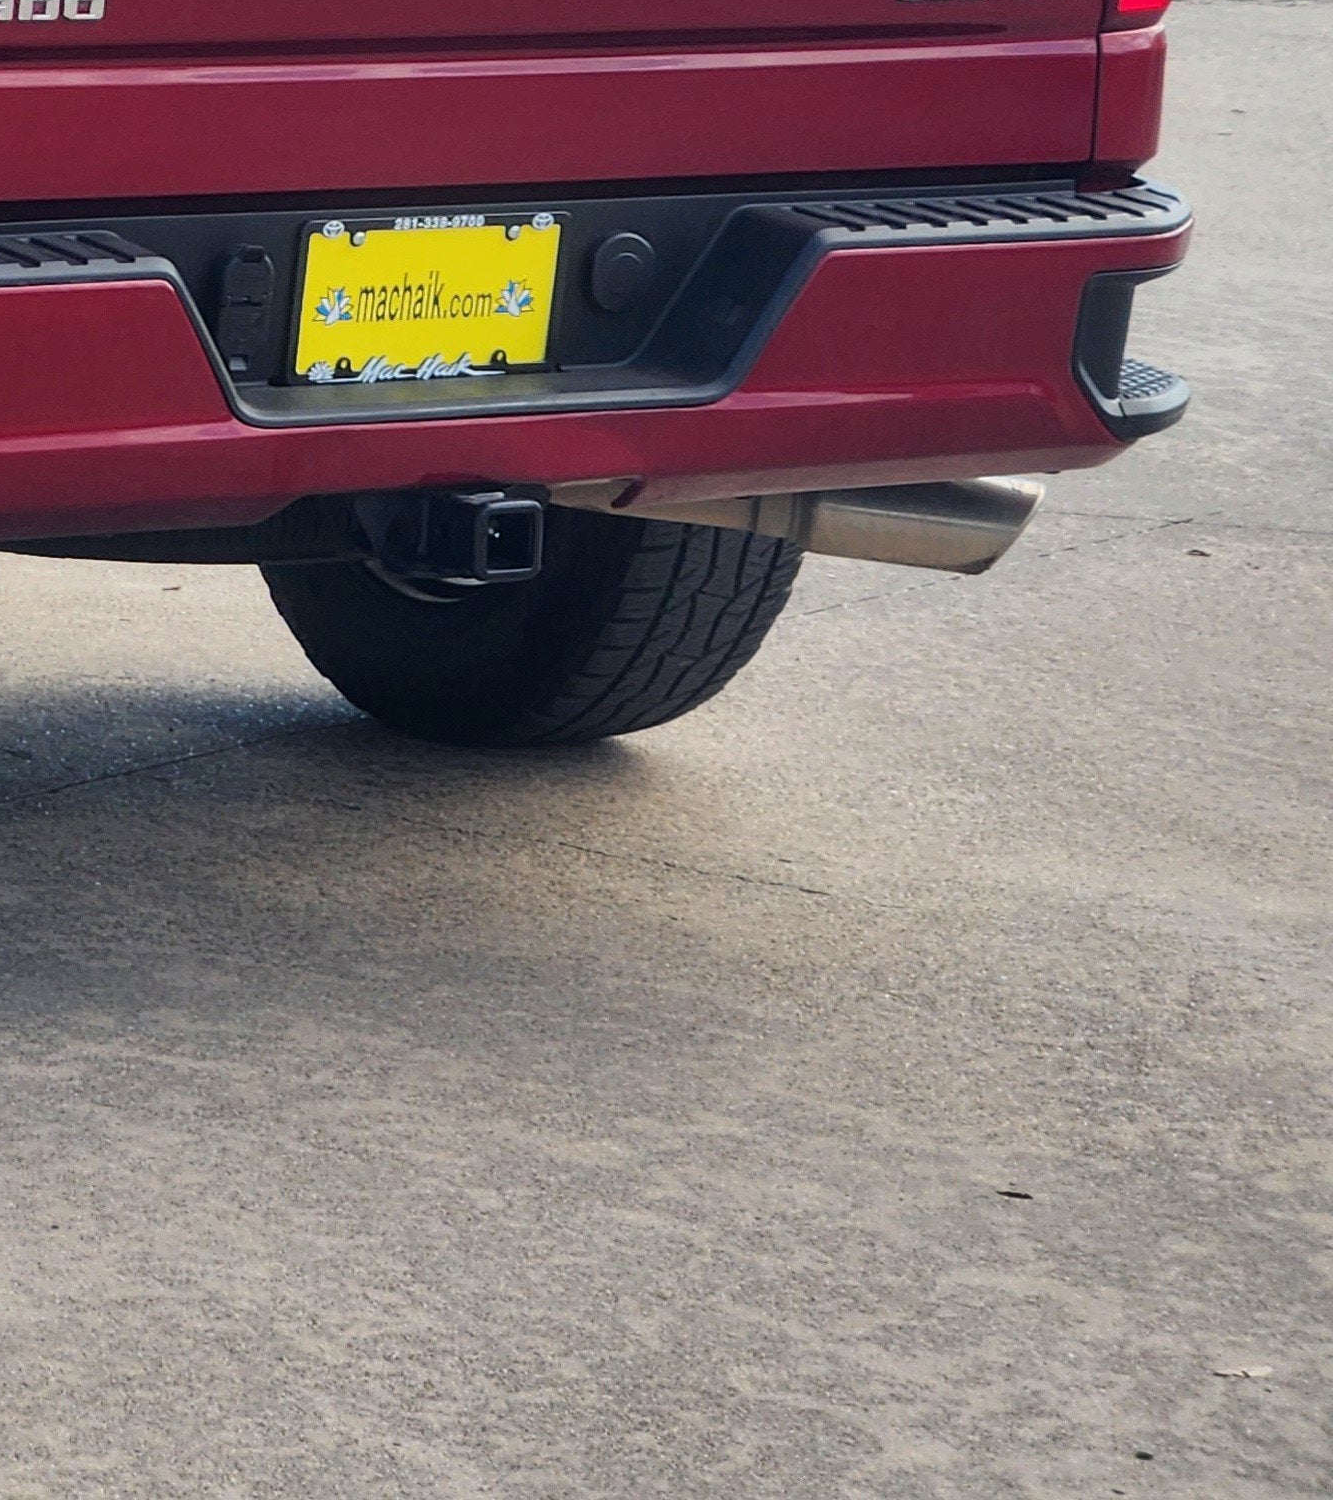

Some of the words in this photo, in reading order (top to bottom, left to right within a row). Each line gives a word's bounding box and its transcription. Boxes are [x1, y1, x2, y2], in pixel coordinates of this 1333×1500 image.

[354, 269, 494, 323] machaik.com
[361, 354, 413, 384] Mac
[414, 351, 481, 381] Haik
